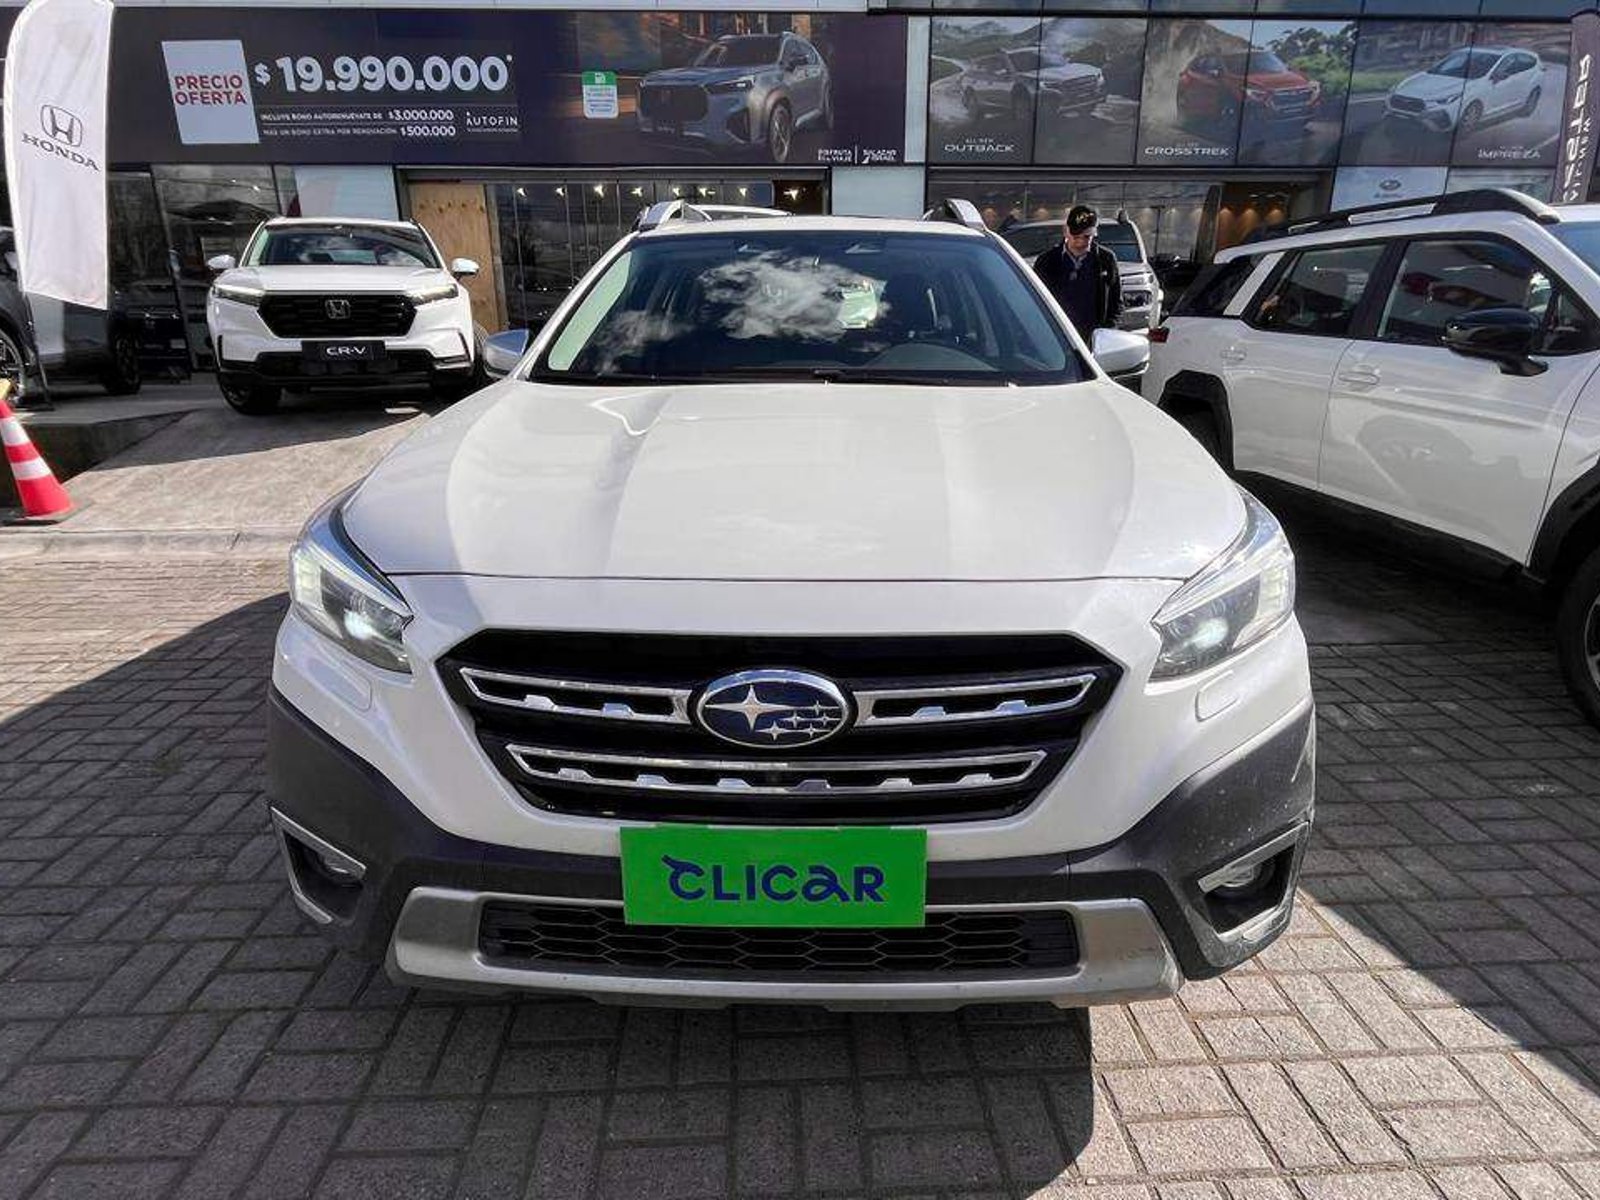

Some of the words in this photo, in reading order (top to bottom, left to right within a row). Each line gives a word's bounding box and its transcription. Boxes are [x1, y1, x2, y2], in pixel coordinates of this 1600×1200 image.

[254, 62, 271, 86] $
[174, 74, 243, 90] PRECIO
[174, 91, 248, 105] OFERTA
[388, 109, 454, 121] $3.000.000
[466, 112, 518, 126] AUTOFIN
[400, 125, 456, 136] $500.000
[21, 132, 101, 172] HONDA
[944, 144, 1015, 152] OUTBACK
[1144, 146, 1229, 156] CROSSTREK
